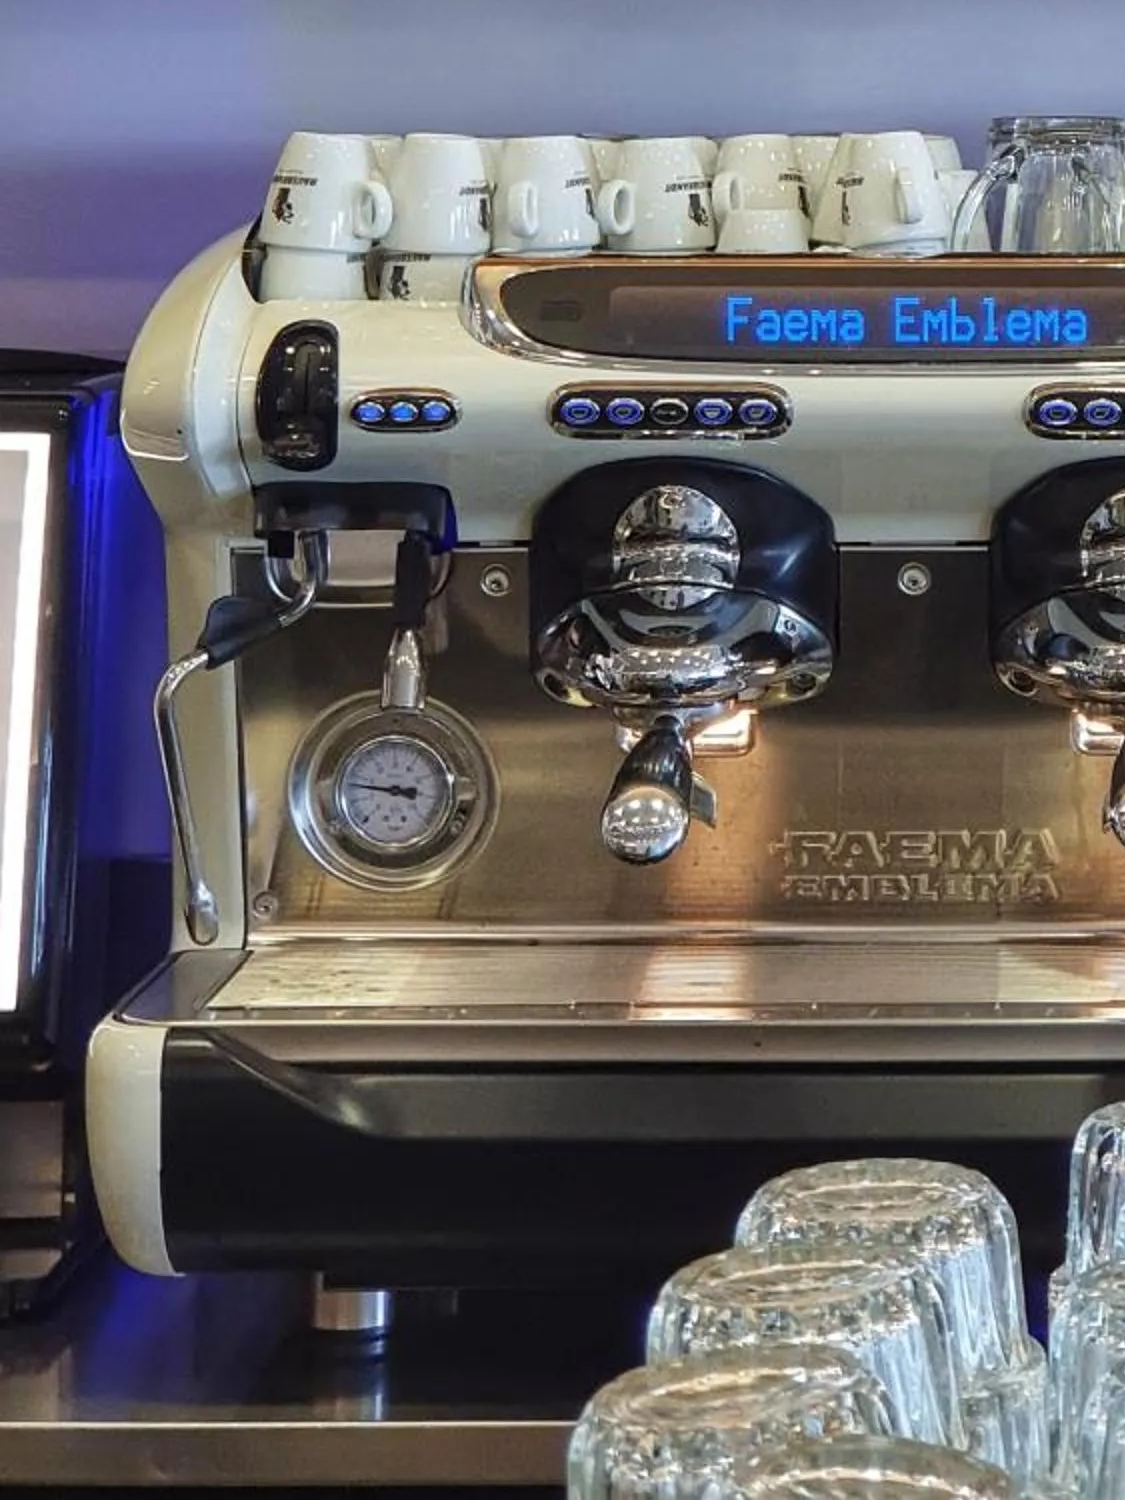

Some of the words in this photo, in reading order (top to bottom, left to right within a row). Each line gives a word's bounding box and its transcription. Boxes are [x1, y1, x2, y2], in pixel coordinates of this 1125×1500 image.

[727, 297, 866, 342] Faema
[894, 297, 1088, 342] Emblema
[770, 828, 1061, 869] FAEMA
[783, 873, 1061, 901] EMBLEMA
